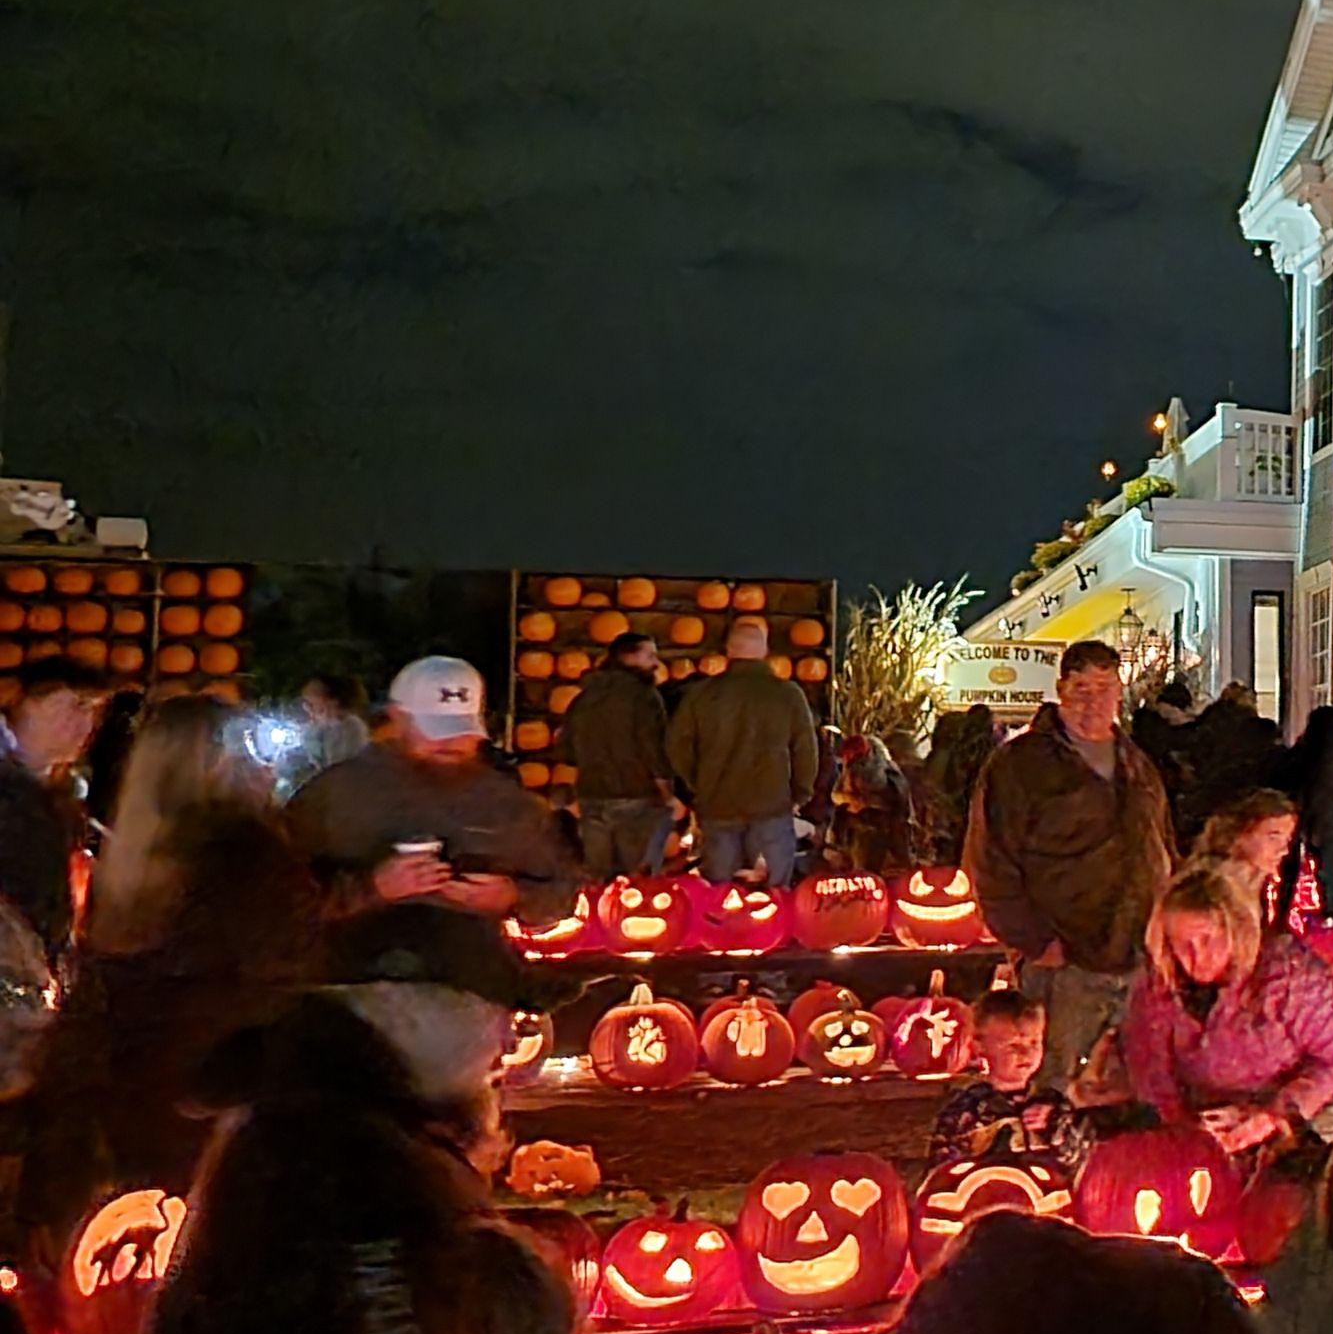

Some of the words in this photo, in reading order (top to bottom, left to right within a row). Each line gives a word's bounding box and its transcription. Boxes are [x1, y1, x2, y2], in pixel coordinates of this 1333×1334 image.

[960, 646, 1010, 660] ELCOME
[1014, 647, 1030, 661] TO
[1034, 649, 1058, 666] THE
[960, 689, 1007, 702] PUMPKIN
[1009, 691, 1045, 704] HOUSE
